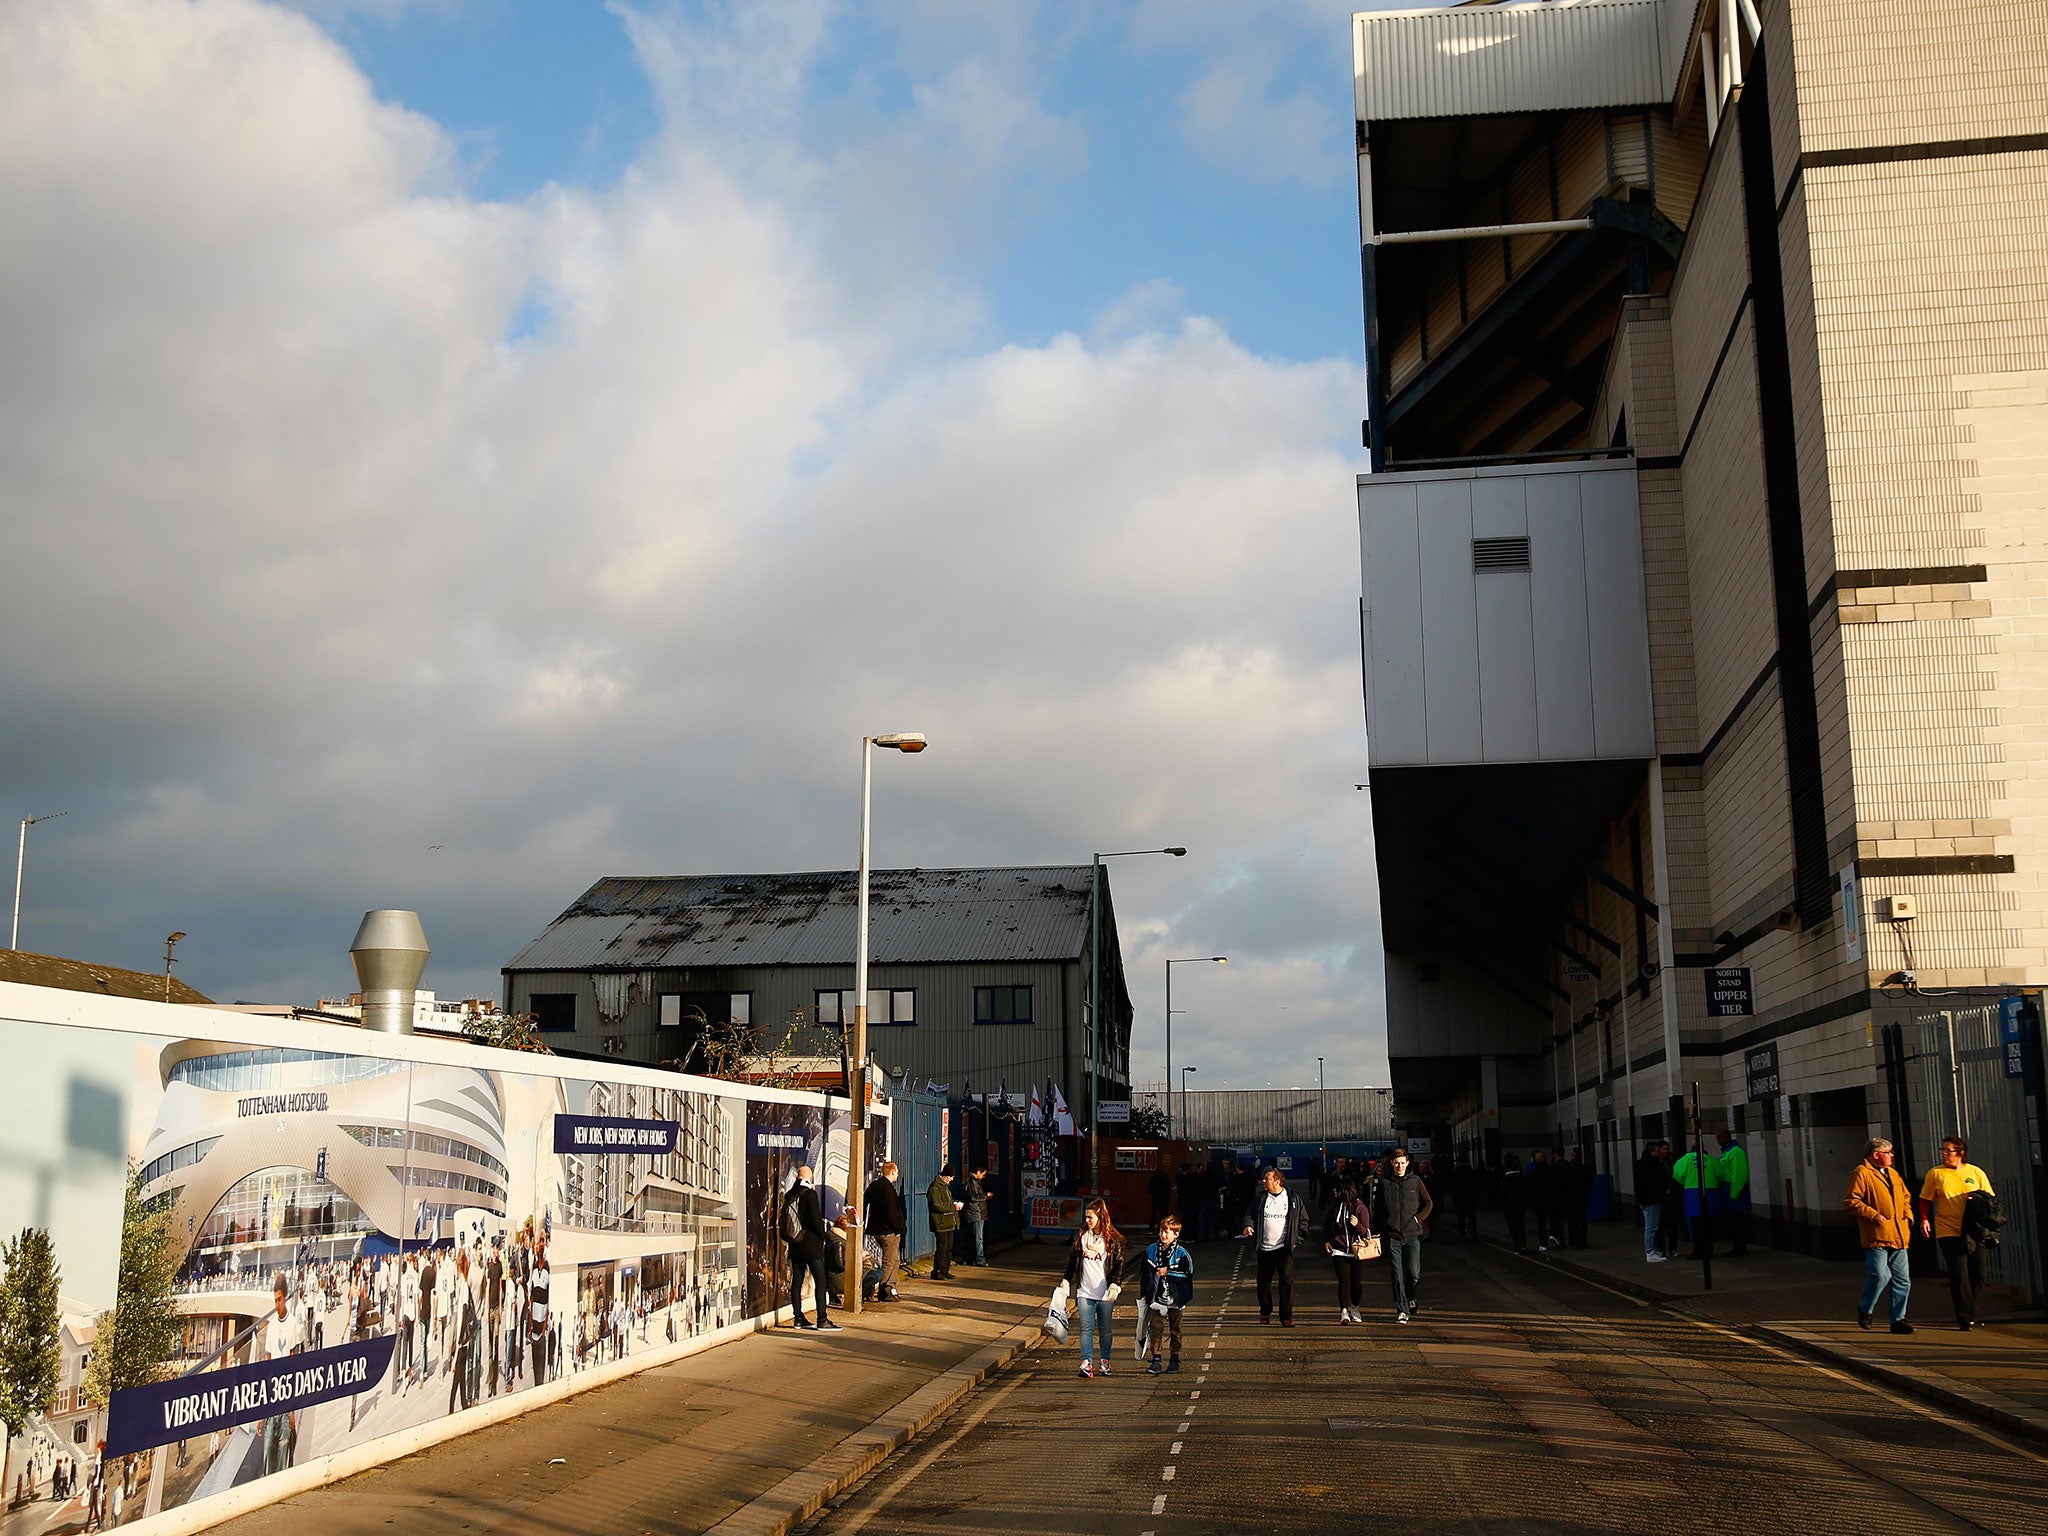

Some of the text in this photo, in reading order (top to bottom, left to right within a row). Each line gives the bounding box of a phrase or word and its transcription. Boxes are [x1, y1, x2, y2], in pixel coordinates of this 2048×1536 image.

[1569, 974, 1589, 982] TIER
[1716, 969, 1742, 978] NORTH
[1717, 979, 1742, 987] STAND
[1713, 990, 1748, 1001] UPPER
[1720, 1003, 1744, 1015] TIER
[237, 1092, 329, 1118] TOTTENHAM HOTSPUR
[574, 1126, 668, 1147] NEW JOBS, NEW SHOPS, NEW HOMES
[757, 1133, 766, 1147] NEW
[1033, 1198, 1059, 1208] EGG &
[1032, 1208, 1059, 1217] BACON
[1032, 1217, 1058, 1227] ROLLS
[164, 1356, 368, 1430] VIBRANT AREA 365 DAYS A YEAR
